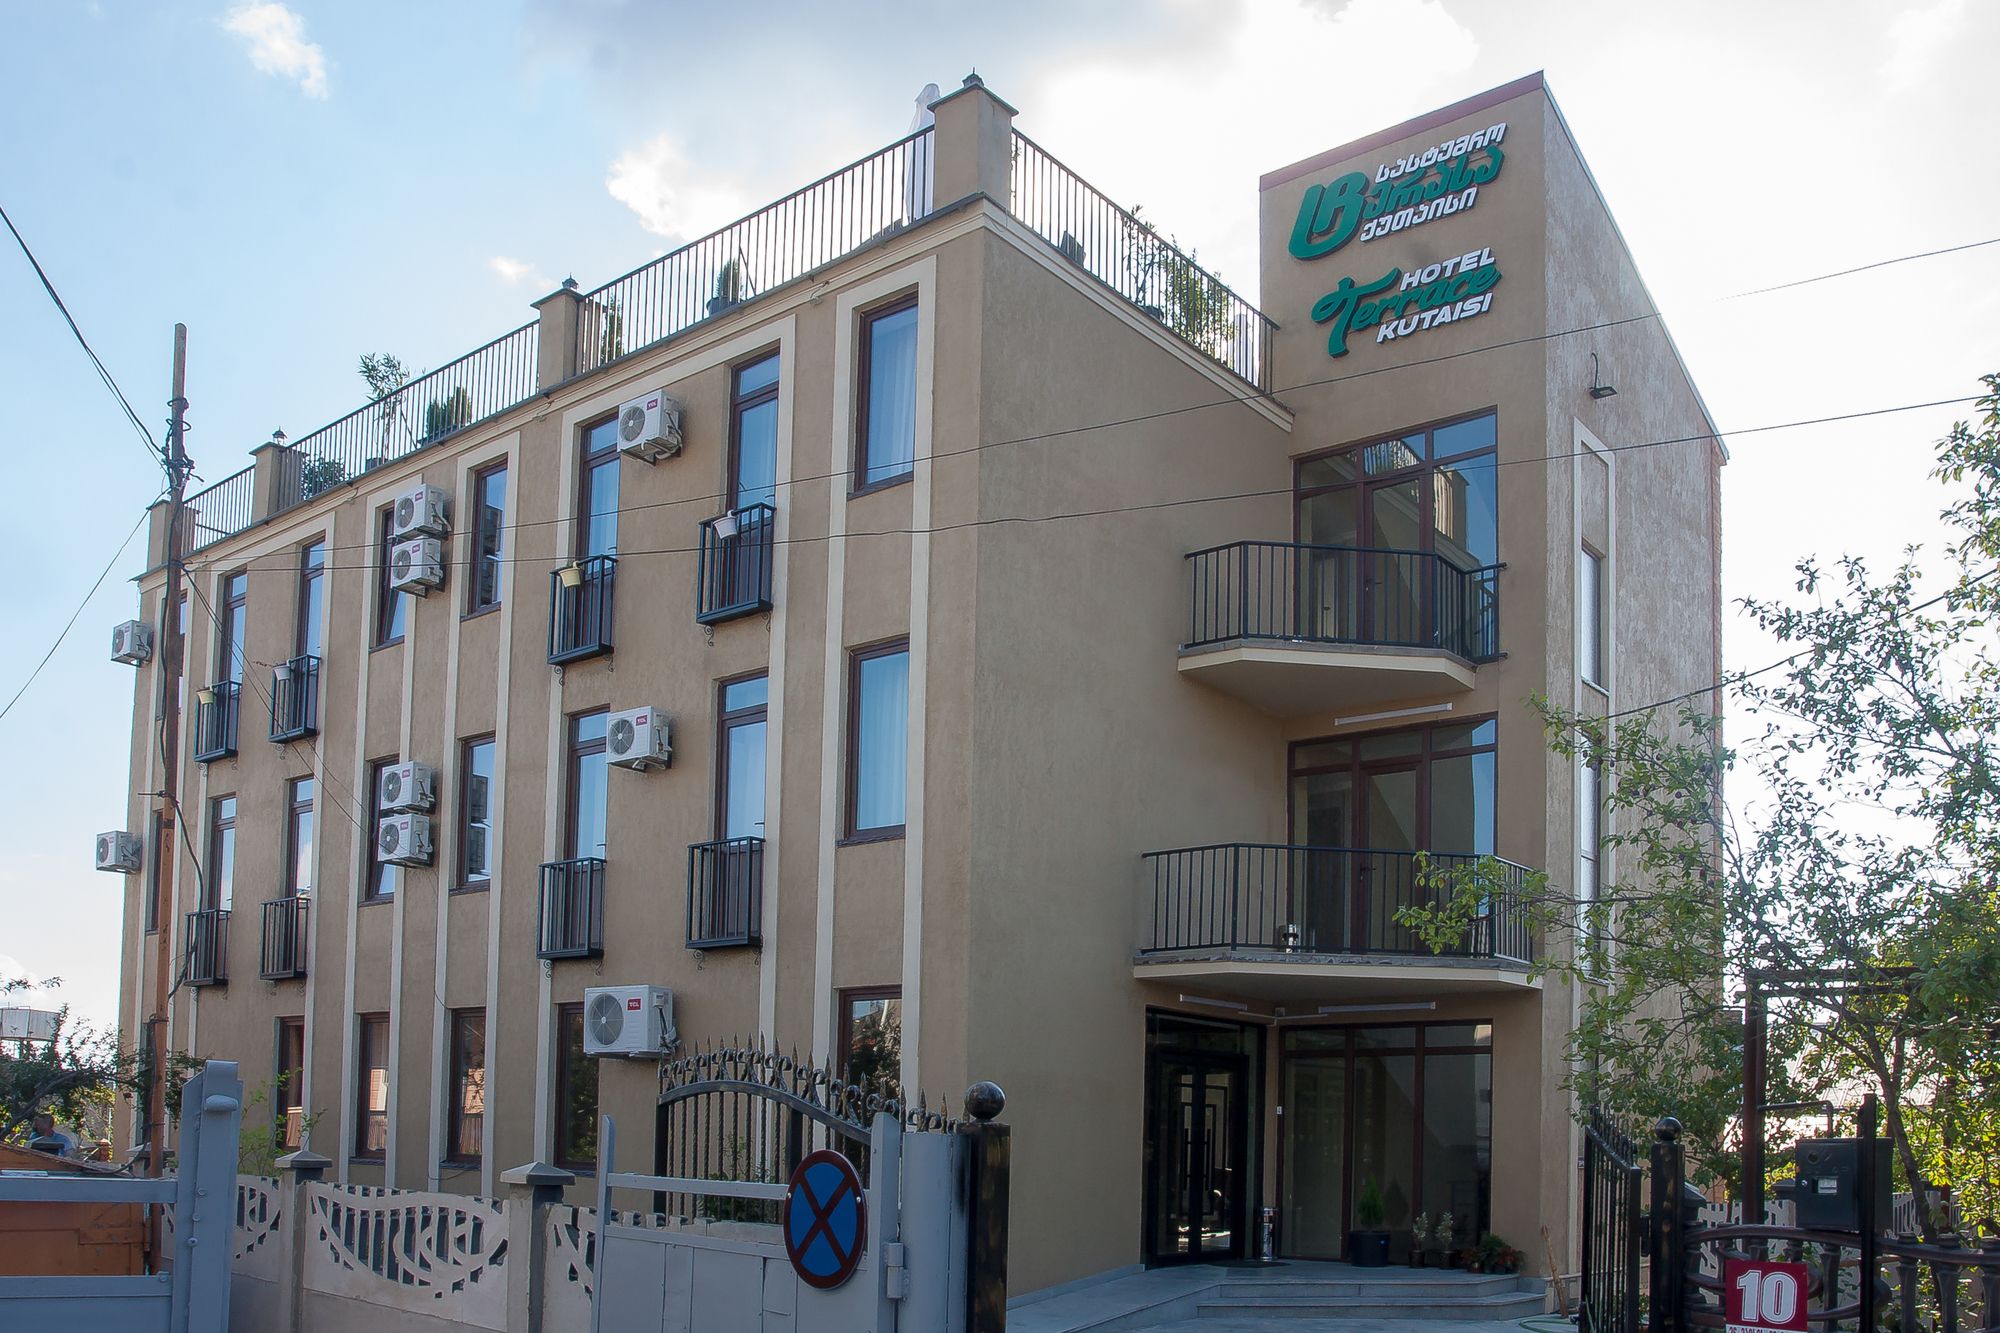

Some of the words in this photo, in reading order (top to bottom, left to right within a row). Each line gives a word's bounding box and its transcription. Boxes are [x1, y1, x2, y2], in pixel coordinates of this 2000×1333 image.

[1374, 122, 1507, 184] სასტუმრო
[1359, 186, 1478, 243] ქუთაისი
[1400, 247, 1495, 291] HOTEL
[1311, 264, 1502, 358] Terrace
[1376, 292, 1493, 344] KUTAISI
[1736, 1269, 1798, 1325] 10
